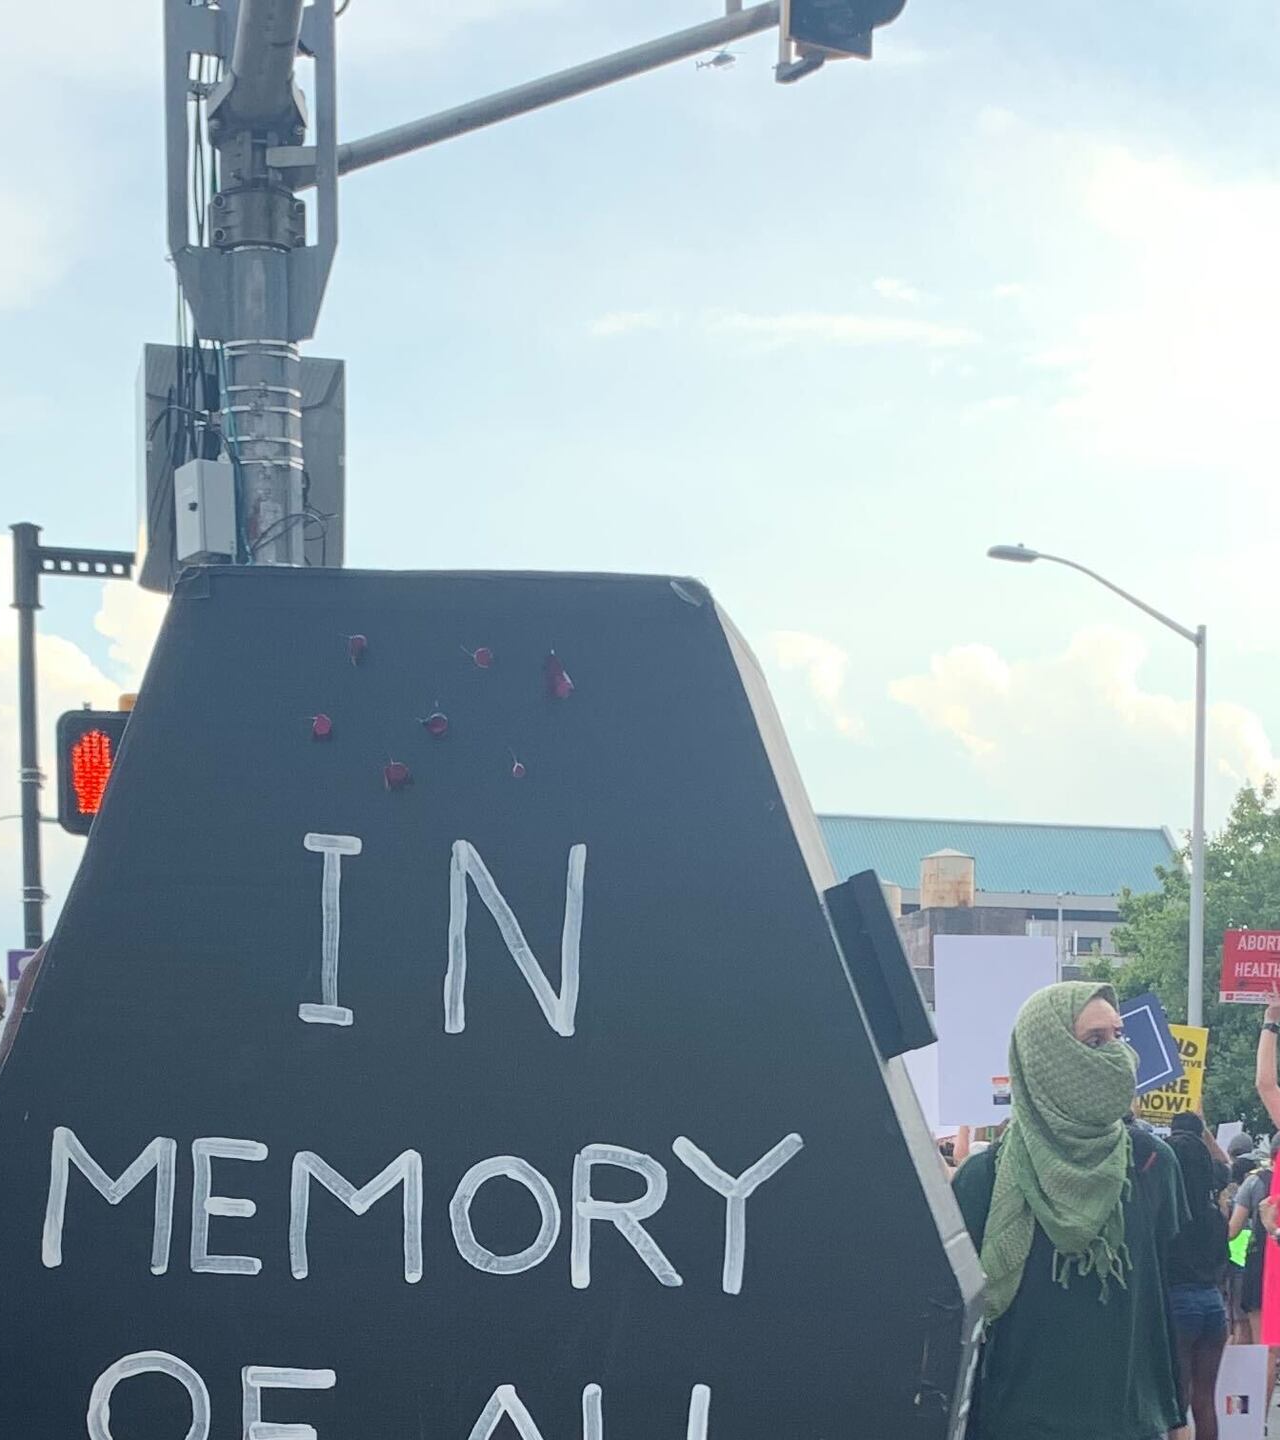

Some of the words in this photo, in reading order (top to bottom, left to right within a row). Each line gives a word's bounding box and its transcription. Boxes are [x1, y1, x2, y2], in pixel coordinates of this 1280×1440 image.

[299, 833, 586, 1036] IN
[1140, 1094, 1192, 1112] NOW!
[42, 1127, 803, 1294] MEMORY
